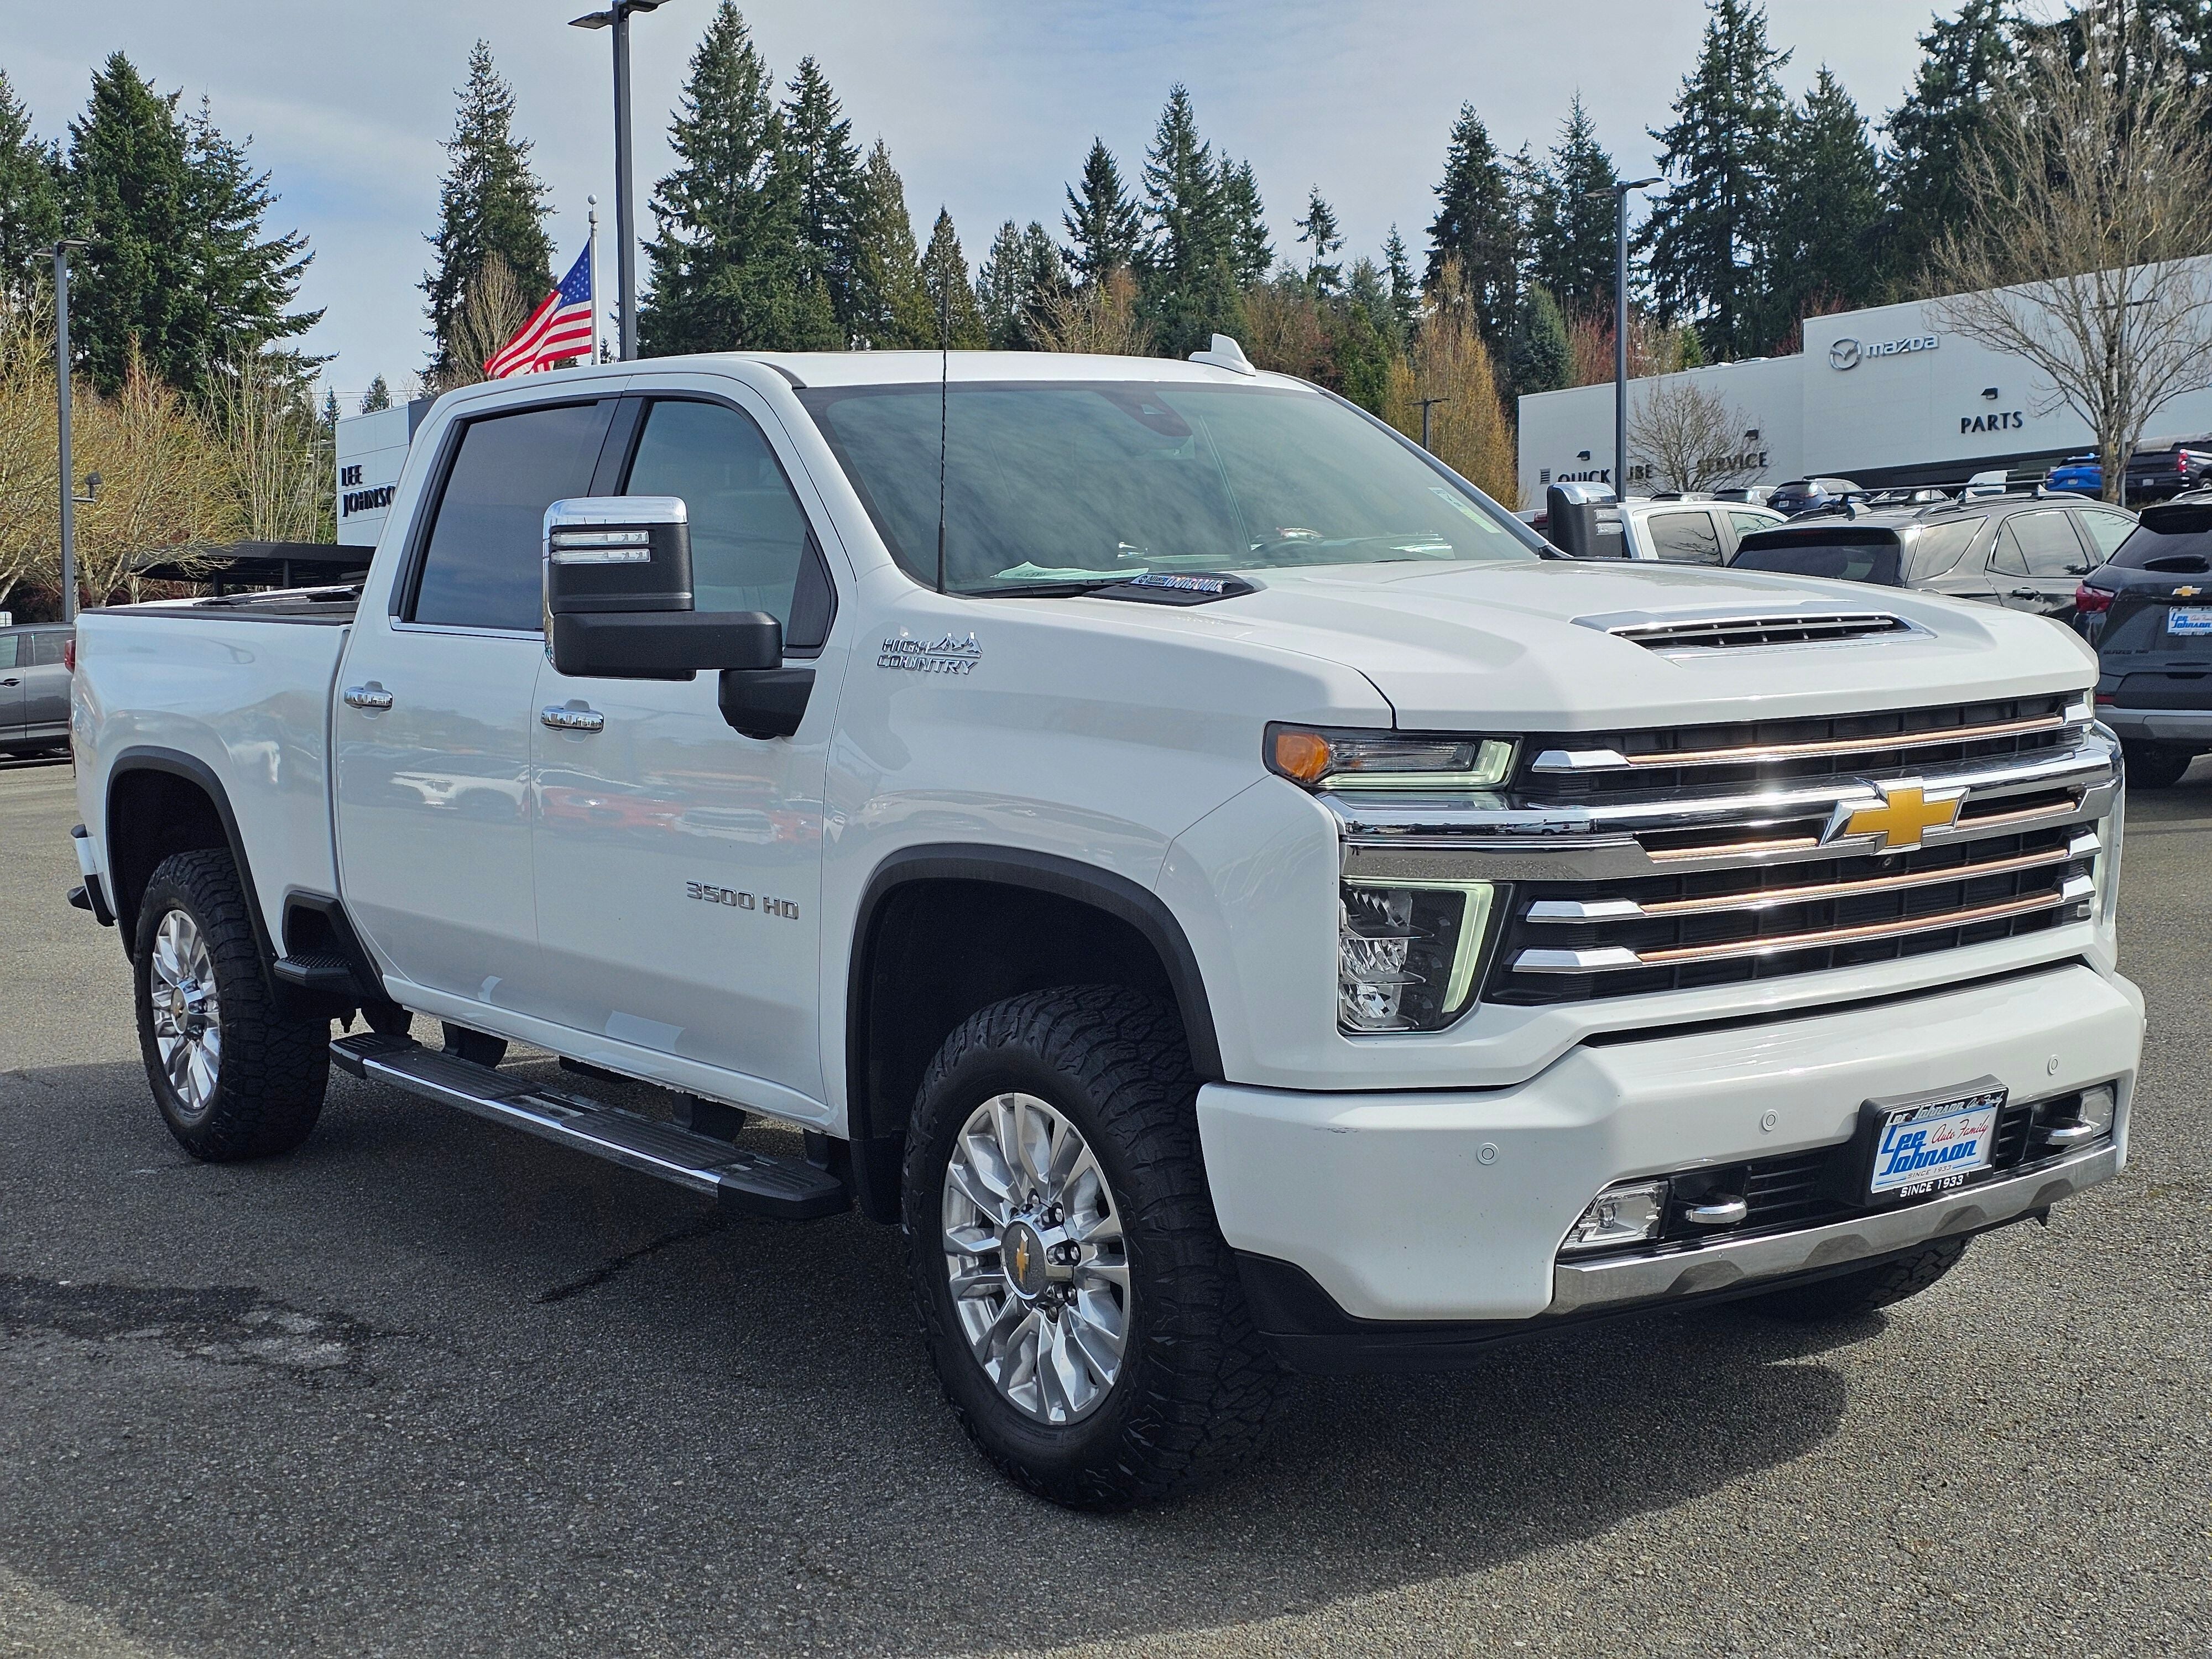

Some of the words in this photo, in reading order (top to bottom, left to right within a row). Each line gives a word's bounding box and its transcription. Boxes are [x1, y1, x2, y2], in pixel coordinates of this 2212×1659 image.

[1960, 411, 2023, 434] PARTS
[341, 465, 363, 487] LEE
[1625, 463, 1652, 481] UBE
[882, 638, 934, 655] HIGH
[877, 654, 979, 675] COUNTRY
[686, 880, 755, 911] 3500
[762, 894, 799, 920] HD
[1912, 1101, 1965, 1120] Johnson
[1881, 1124, 1927, 1155] Lee
[1932, 1124, 1956, 1144] Auto
[1957, 1114, 1991, 1140] Family
[1879, 1139, 1978, 1177] Johnson
[1907, 1169, 1930, 1180] SINCE
[1934, 1164, 1952, 1173] 1933
[1900, 1182, 1934, 1198] SINCE
[1937, 1175, 1964, 1190] 1933
